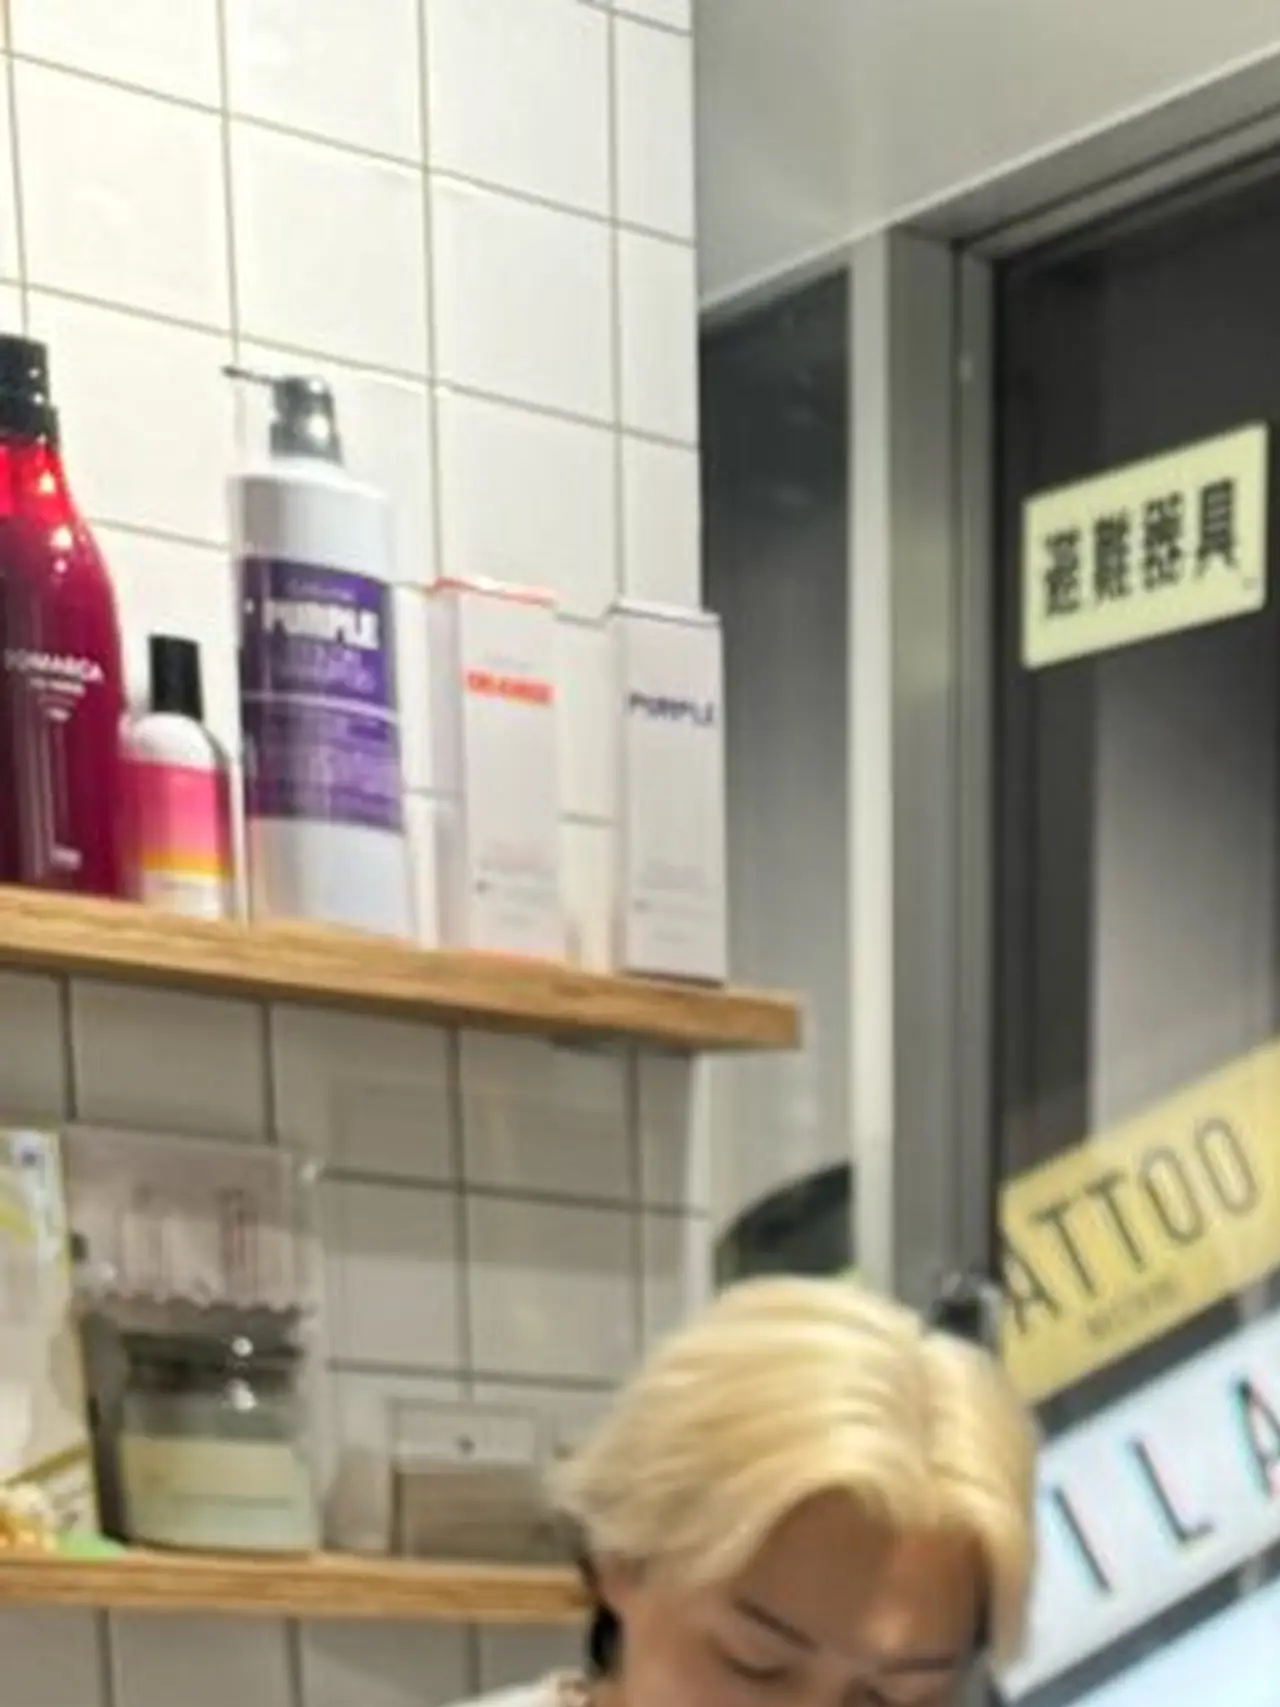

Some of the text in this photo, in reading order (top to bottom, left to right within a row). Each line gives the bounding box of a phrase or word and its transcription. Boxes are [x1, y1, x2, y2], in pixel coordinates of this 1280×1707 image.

[1044, 478, 1236, 618] 避難器具
[262, 599, 380, 650] PURPLE
[628, 692, 715, 728] PURPLE
[1002, 1117, 1257, 1334] ATTOO
